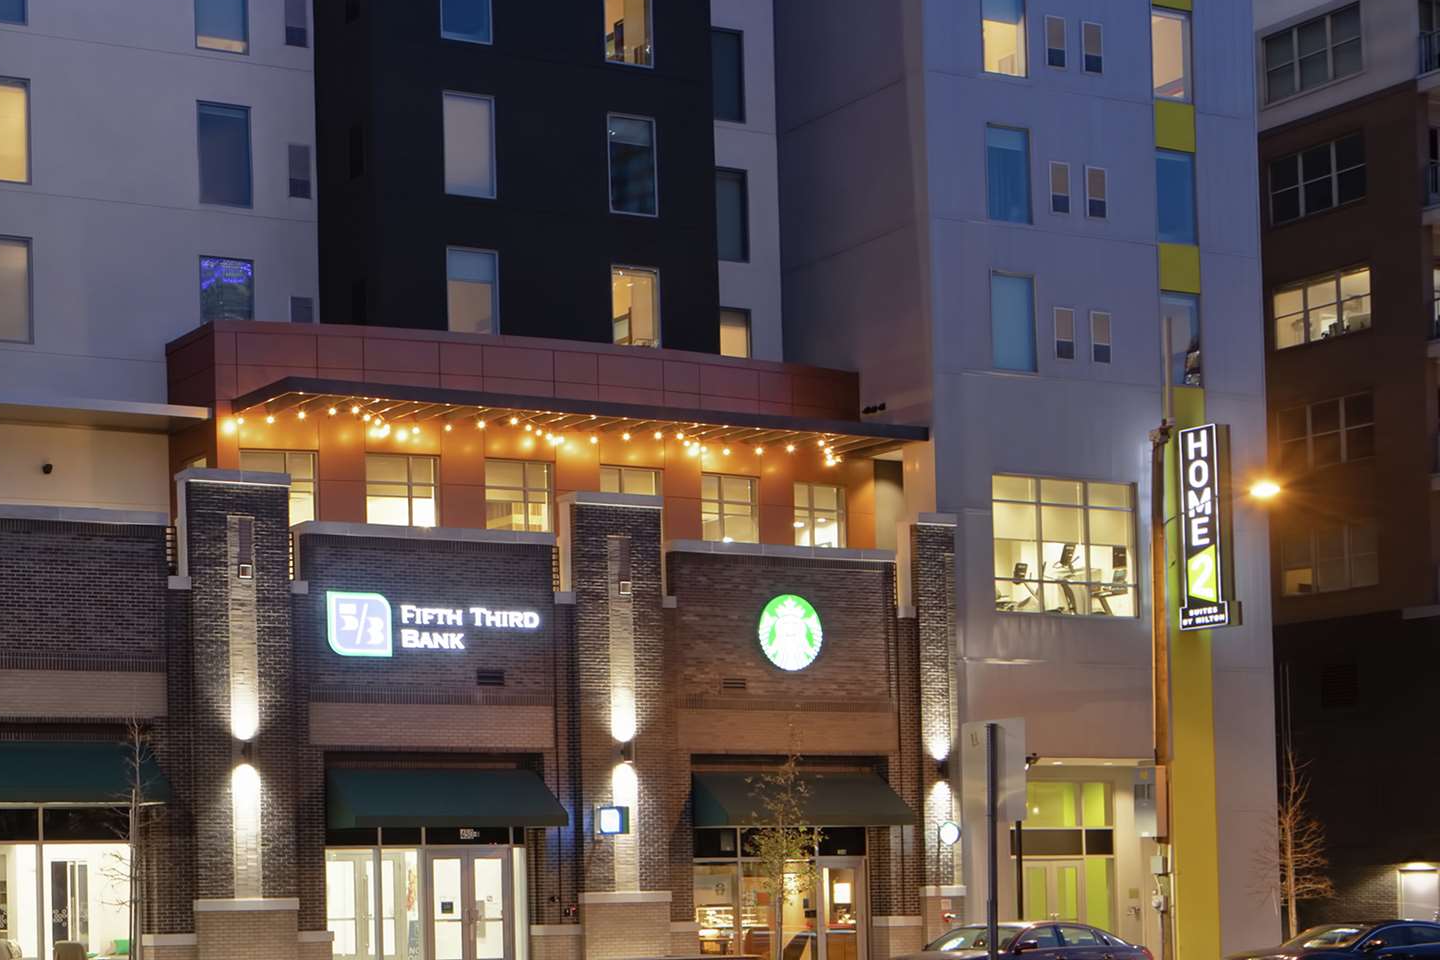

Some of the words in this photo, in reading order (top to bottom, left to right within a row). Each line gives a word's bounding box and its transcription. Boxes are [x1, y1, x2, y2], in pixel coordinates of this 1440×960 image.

[1186, 429, 1212, 547] HOME
[1190, 552, 1214, 599] 2
[400, 604, 463, 627] FIFTH
[469, 606, 541, 629] THIRD
[400, 628, 466, 650] BANK
